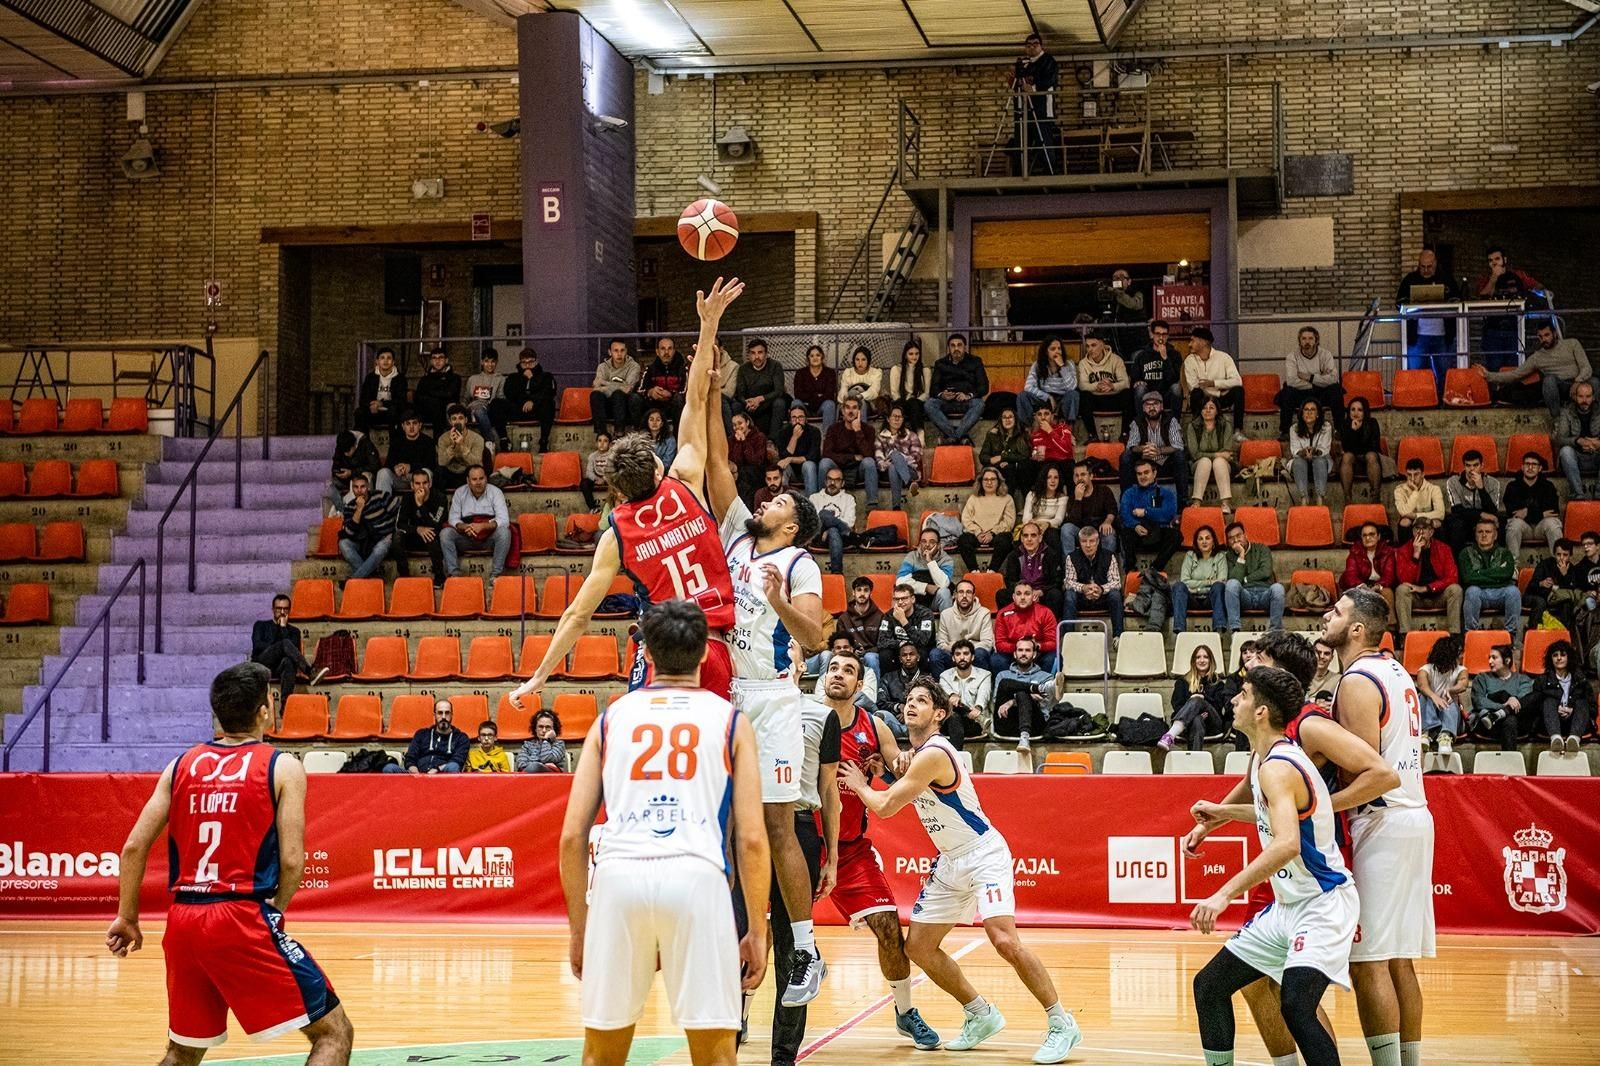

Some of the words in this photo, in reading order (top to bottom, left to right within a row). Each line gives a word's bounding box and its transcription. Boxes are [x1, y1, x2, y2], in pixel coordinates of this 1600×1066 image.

[543, 196, 561, 223] B
[1161, 293, 1205, 305] LLÉVATELA
[1161, 306, 1182, 318] BIEN
[1252, 420, 1269, 431] 40
[1461, 416, 1478, 426] 44
[564, 432, 580, 442] 26
[64, 442, 78, 452] 20
[109, 441, 122, 451] 21
[544, 498, 561, 508] 26
[943, 494, 960, 504] 34
[31, 506, 46, 516] 20
[77, 506, 91, 516] 21
[1303, 557, 1318, 568] 41
[321, 566, 337, 576] 22
[518, 563, 535, 574] 26
[569, 563, 585, 574] 27
[661, 545, 709, 602] 15
[738, 563, 752, 583] 10
[42, 570, 55, 580] 21
[497, 627, 513, 637] 26
[6, 633, 20, 643] 21
[630, 723, 700, 781] 28
[774, 766, 792, 784] 10
[189, 793, 198, 815] F.
[200, 790, 239, 814] LÓPEZ
[195, 821, 223, 884] 2
[313, 850, 328, 860] de
[0, 841, 120, 878] Blanca
[304, 865, 330, 875] cios
[482, 860, 514, 877] JAÉN
[1116, 861, 1168, 879] UNED
[1203, 864, 1226, 877] JAÉN
[299, 879, 329, 889] colas
[373, 877, 447, 890] CLIMBING
[452, 876, 515, 889] CENTER
[986, 888, 1003, 904] 11
[1293, 935, 1305, 952] 6
